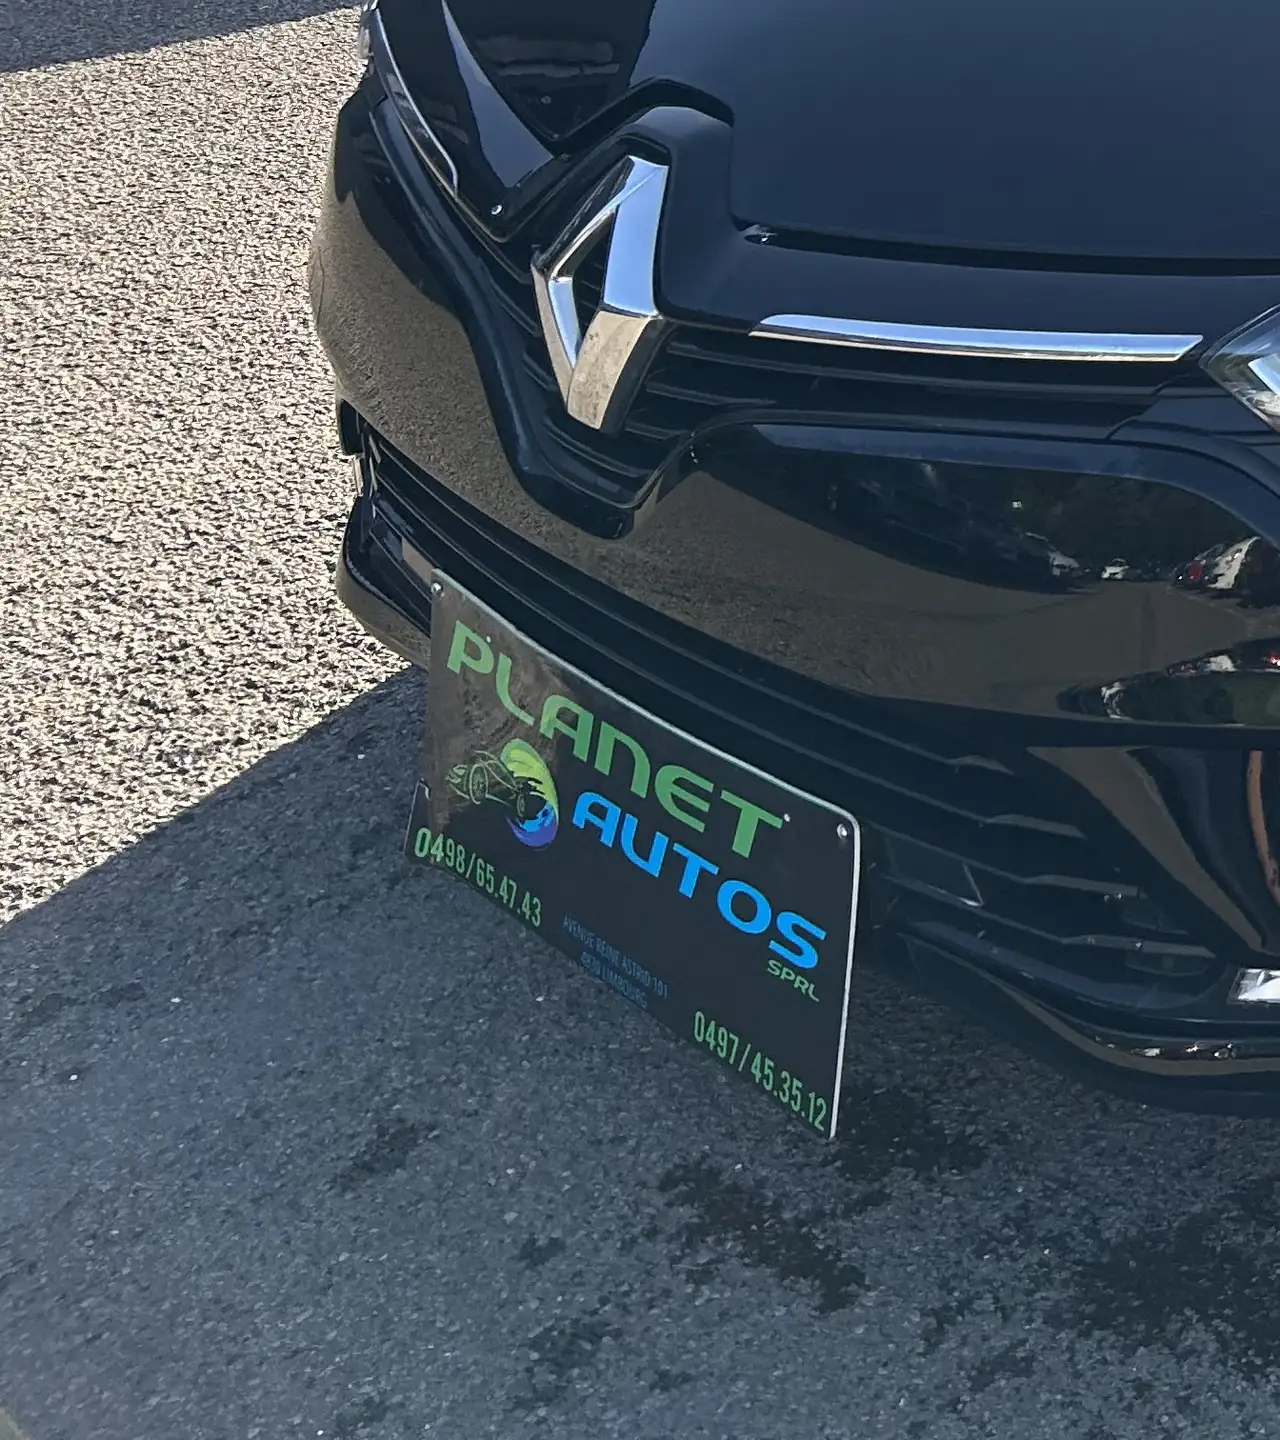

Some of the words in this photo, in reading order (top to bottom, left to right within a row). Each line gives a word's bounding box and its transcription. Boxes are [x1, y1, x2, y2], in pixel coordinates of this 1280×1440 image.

[446, 620, 783, 858] PLANET
[414, 827, 542, 927] 0498/65.47.43
[571, 791, 827, 970] AUTOS
[766, 959, 820, 1002] SPRL
[692, 1009, 828, 1132] 0497/45.35.12
